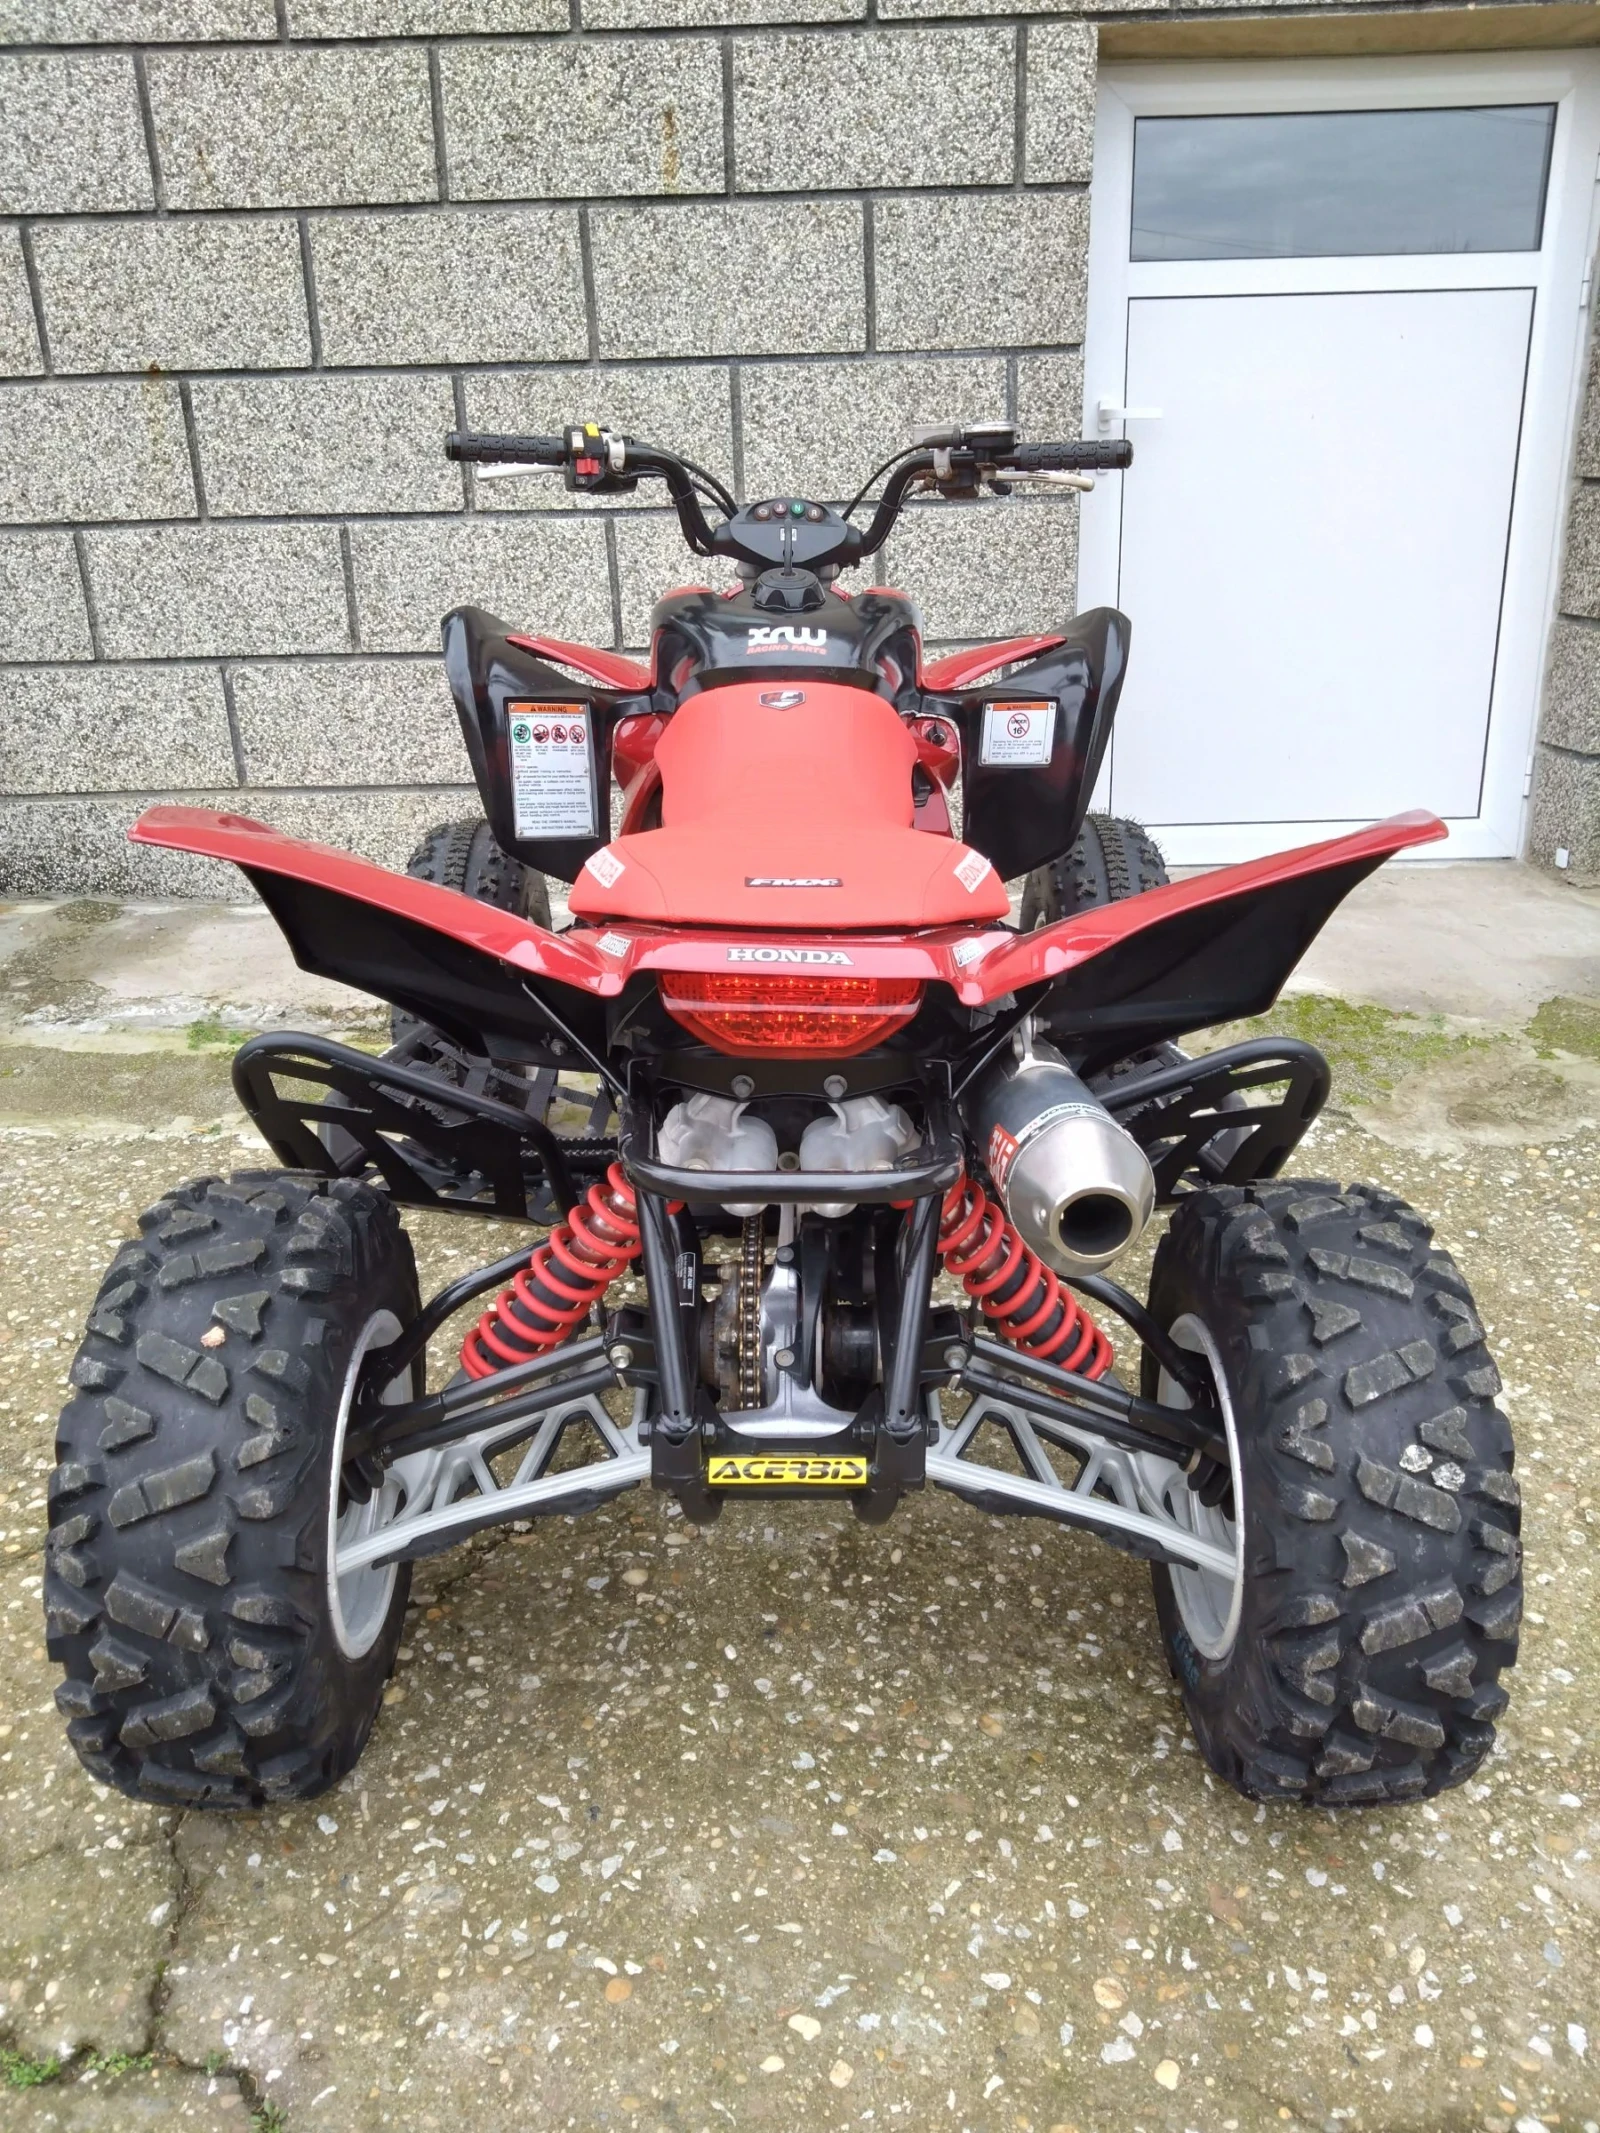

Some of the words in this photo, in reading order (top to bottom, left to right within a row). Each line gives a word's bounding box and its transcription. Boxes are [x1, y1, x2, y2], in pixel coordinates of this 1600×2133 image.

[746, 644, 789, 655] RACING
[791, 644, 828, 656] PARTS
[538, 704, 569, 714] WARNING
[1013, 727, 1022, 735] 16
[727, 948, 855, 966] HONDA
[712, 1460, 863, 1480] ACERBIS
